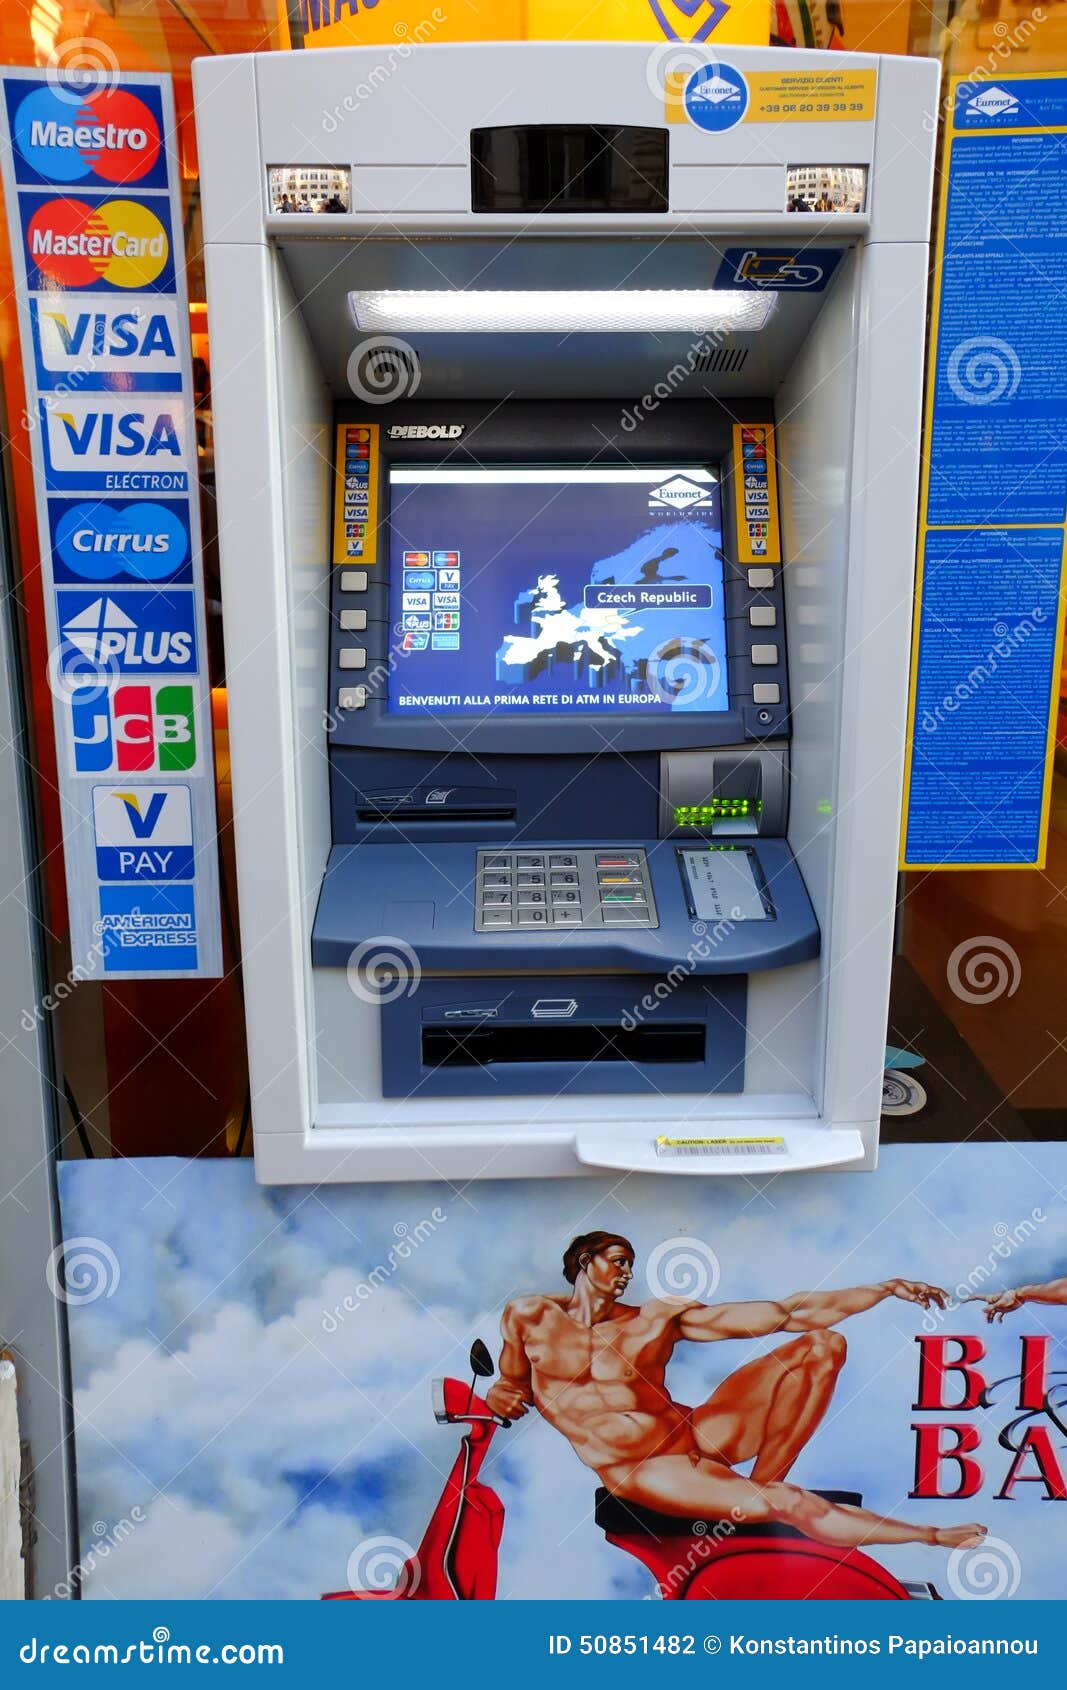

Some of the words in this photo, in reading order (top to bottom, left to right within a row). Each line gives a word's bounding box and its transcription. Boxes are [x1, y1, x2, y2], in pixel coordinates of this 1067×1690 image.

[976, 97, 1011, 107] Euronet
[30, 120, 148, 150] Maestro
[32, 228, 164, 258] MasterCard
[42, 312, 176, 358] VISA
[52, 412, 182, 456] VISA
[387, 425, 464, 438] DIEBOLD
[106, 474, 184, 489] ELECTRON
[659, 488, 701, 498] Euronet
[347, 509, 368, 517] VISA
[73, 529, 170, 553] Cirrus
[407, 598, 427, 606] VISA
[597, 592, 636, 603] Czech
[640, 592, 697, 605] Republic
[99, 631, 193, 665] PLUS
[399, 696, 460, 706] BENVENUTI
[463, 696, 491, 705] ALLA
[494, 695, 530, 705] PRIMA
[532, 695, 558, 705] RETE
[561, 695, 573, 704] DI
[576, 695, 600, 704] ATM
[603, 695, 615, 704] IN
[618, 694, 661, 704] EUROPA
[110, 793, 168, 838] V
[119, 851, 173, 874] PAY
[531, 858, 541, 867] 2
[563, 857, 573, 866] 3
[499, 876, 508, 884] 4
[531, 875, 541, 883] 5
[565, 874, 574, 883] 6
[500, 893, 508, 903] 7
[532, 892, 542, 902] 8
[566, 892, 576, 902] 9
[102, 915, 190, 930] AMERICAN
[533, 911, 542, 921] 0
[122, 932, 197, 946] EXPRESS
